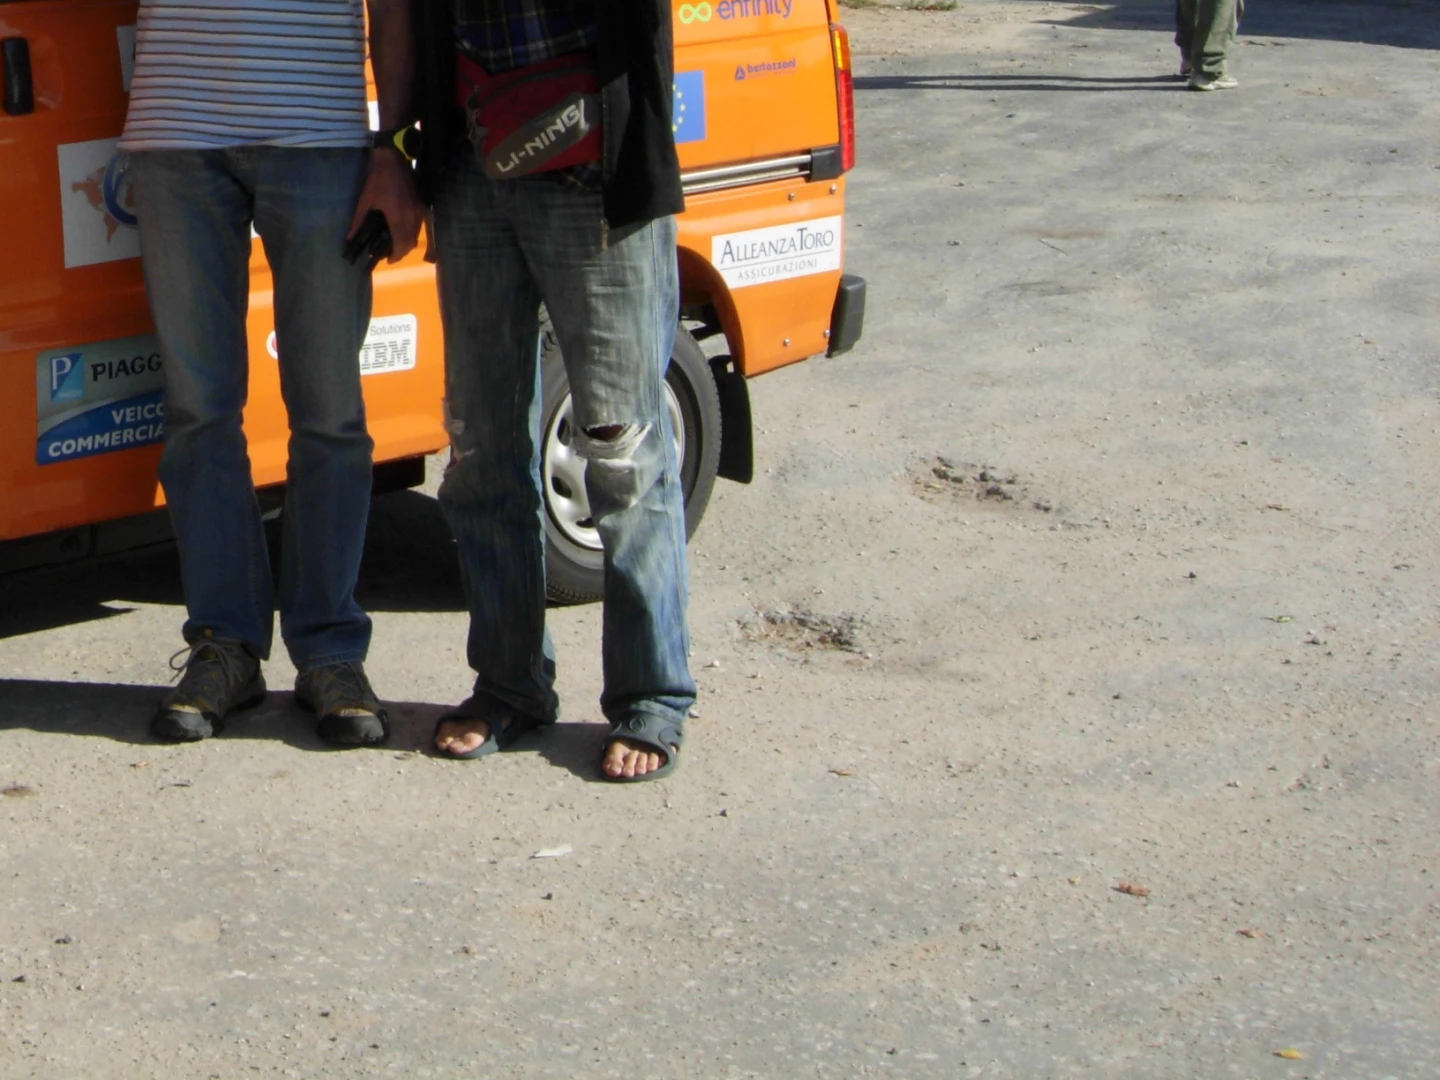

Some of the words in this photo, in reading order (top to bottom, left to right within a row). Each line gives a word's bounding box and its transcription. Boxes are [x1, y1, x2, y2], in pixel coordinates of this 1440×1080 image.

[496, 104, 580, 173] LI-NING
[737, 258, 817, 281] ASSICURAZIONI
[369, 324, 412, 336] Solutions
[361, 339, 413, 370] IBM
